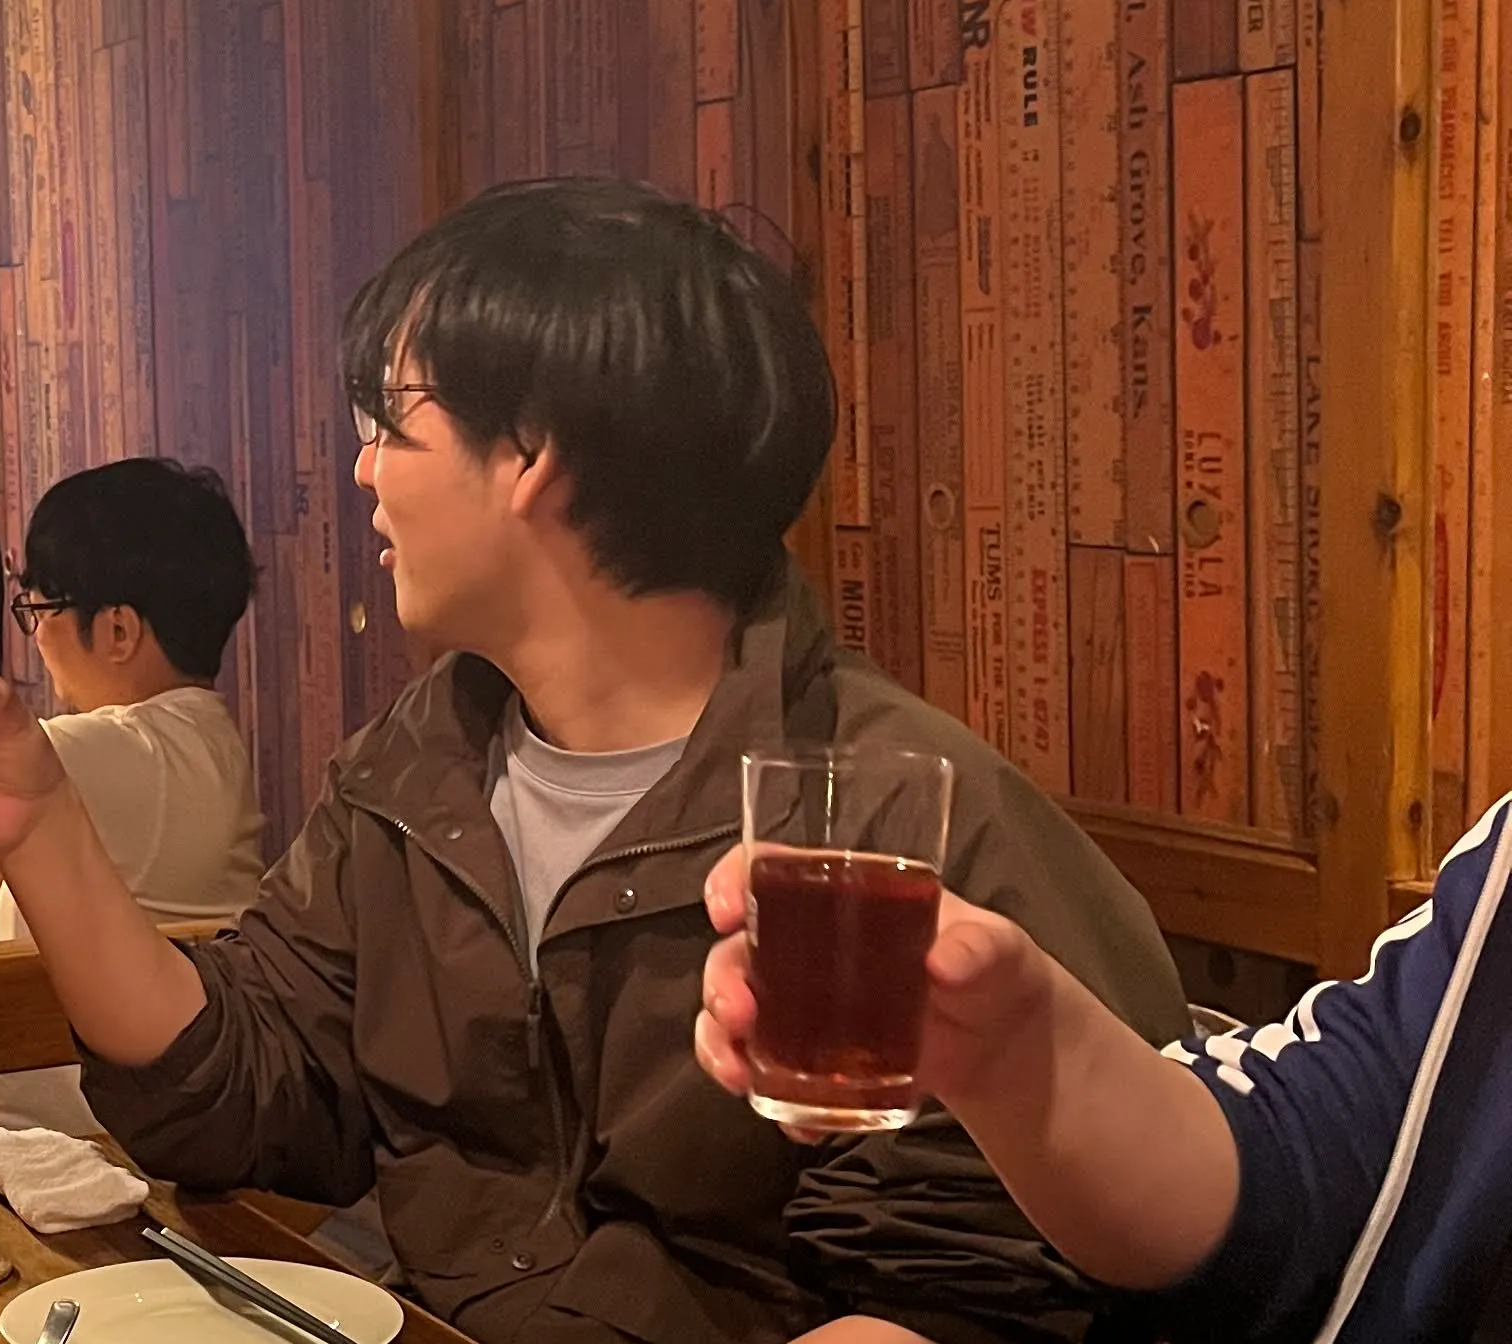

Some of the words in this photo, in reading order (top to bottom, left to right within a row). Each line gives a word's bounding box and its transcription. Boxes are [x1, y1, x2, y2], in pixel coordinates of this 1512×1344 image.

[1023, 45, 1039, 128] RULE
[1128, 50, 1151, 130] Ash
[1438, 86, 1457, 200] PHARMACIST
[1129, 149, 1152, 286] Grove,
[1437, 271, 1453, 308] YOU
[1133, 304, 1155, 419] Kans.
[1436, 322, 1453, 378] ABOUT
[1305, 355, 1322, 467] LAKE
[986, 523, 1005, 601] TUMS
[992, 612, 1004, 647] FOR
[1031, 568, 1050, 665] EXPRESS
[992, 656, 1005, 691] THE
